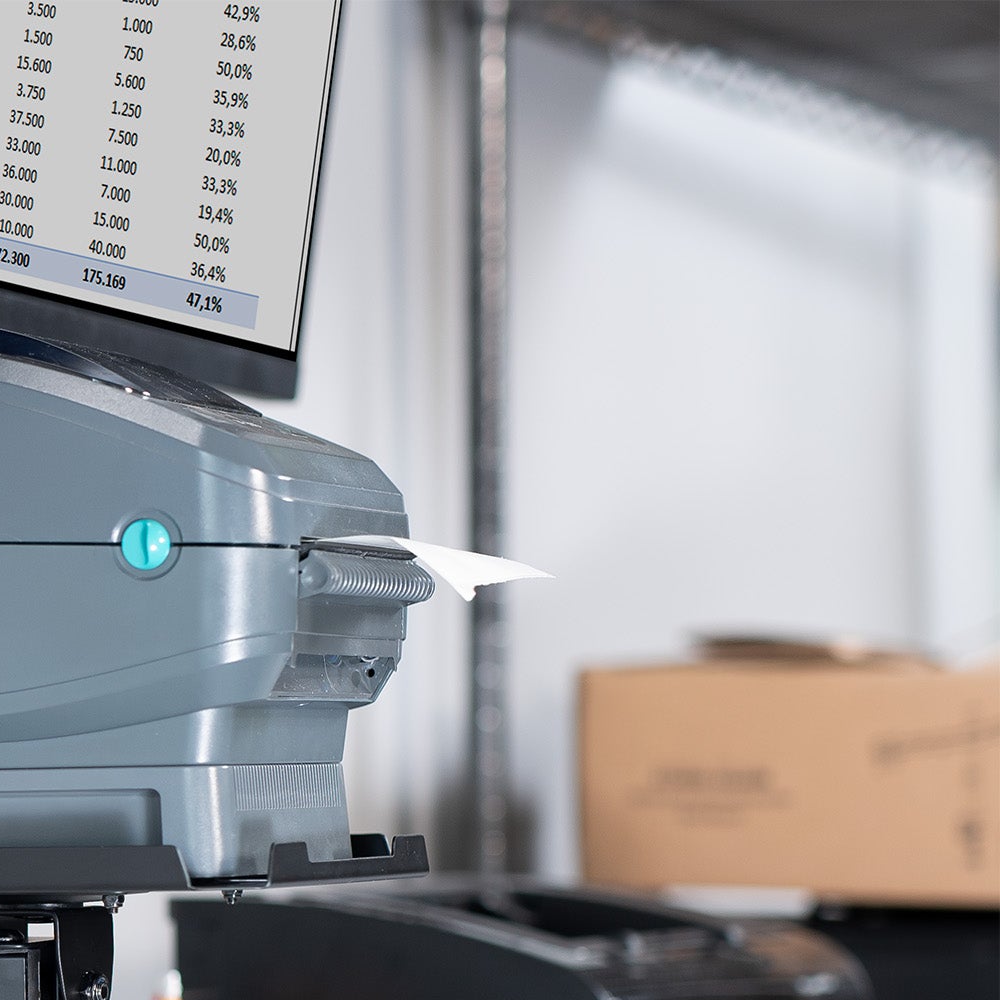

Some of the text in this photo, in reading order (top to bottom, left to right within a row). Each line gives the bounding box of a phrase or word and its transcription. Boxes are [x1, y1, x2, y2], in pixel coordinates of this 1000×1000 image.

[27, 1, 257, 52] 3.500 1.000 28,6%
[223, 3, 260, 23] 42,9%
[23, 28, 53, 47] 1.500
[124, 45, 144, 62] 750
[216, 60, 253, 81] 50,0%
[16, 55, 53, 74] 15.600
[114, 72, 146, 91] 5.600
[213, 89, 249, 110] 35,9%
[16, 82, 46, 101] 3.750
[111, 100, 142, 119] 1.250
[209, 118, 245, 139] 33,3%
[9, 109, 45, 129] 37.500
[108, 127, 139, 147] 7.500
[205, 146, 242, 167] 20,0%
[5, 136, 42, 156] 33.000
[100, 155, 138, 176] 11.000
[201, 175, 238, 196] 33,3%
[2, 163, 38, 184] 36.000
[101, 183, 131, 204] 7.000
[198, 204, 234, 225] 19,4%
[92, 211, 130, 232] 15.000
[193, 232, 230, 254] 50,0%
[88, 239, 127, 260] 40.000
[190, 261, 226, 283] 36,4%
[82, 267, 127, 291] 175.169
[185, 292, 223, 314] 47,1%
